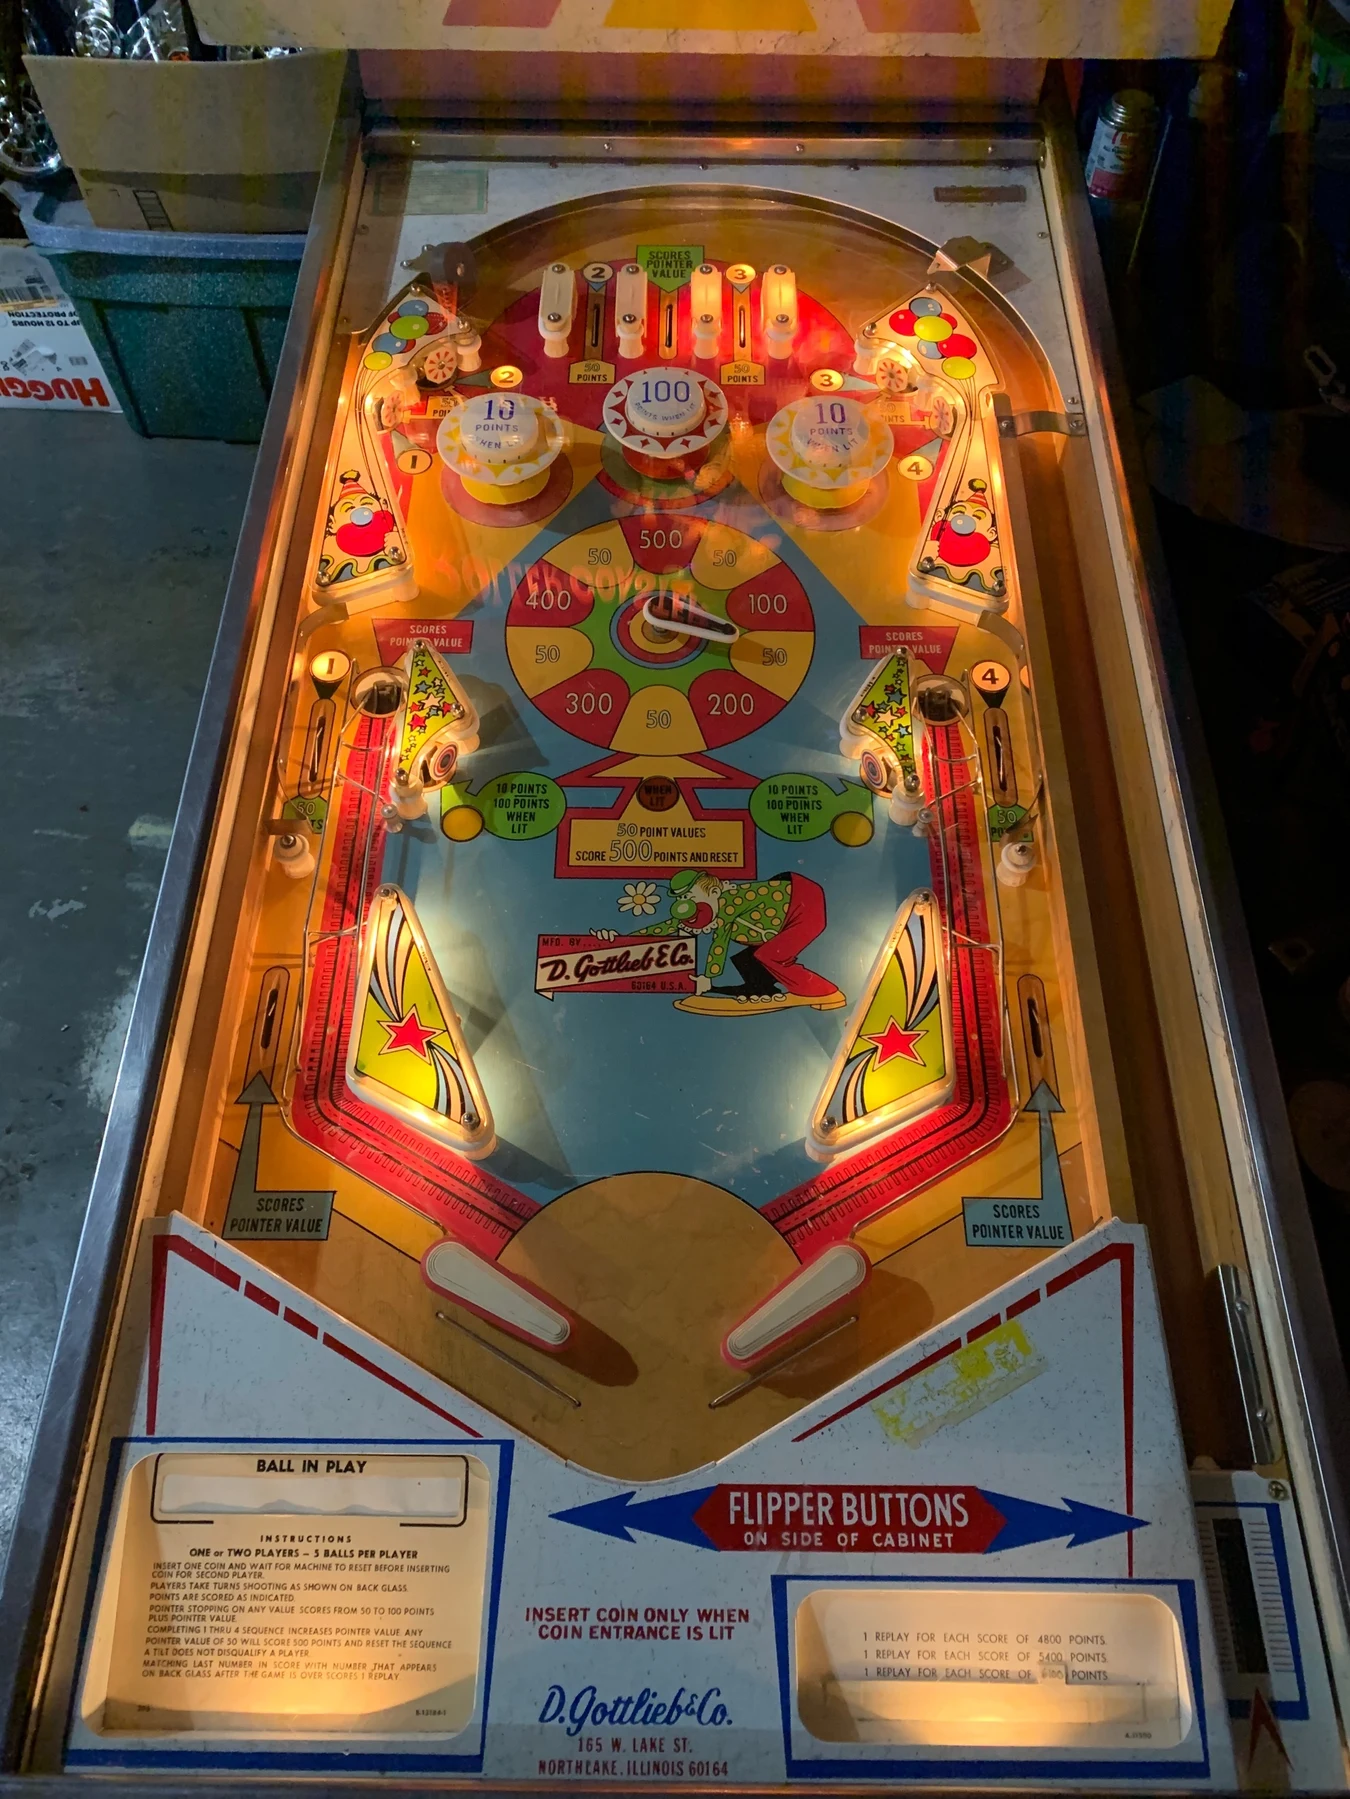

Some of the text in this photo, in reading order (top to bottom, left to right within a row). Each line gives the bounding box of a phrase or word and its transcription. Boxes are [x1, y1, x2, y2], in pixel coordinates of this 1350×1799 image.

[648, 251, 691, 260] SCORES
[646, 260, 693, 269] POINTER
[590, 267, 605, 279] 2
[652, 269, 686, 278] VALUE
[733, 269, 747, 280] 3
[499, 371, 514, 384] 2
[576, 373, 608, 382] POINTS
[727, 374, 759, 383] POINTS
[820, 373, 834, 387] 3
[642, 380, 690, 403] 100
[483, 399, 515, 421] 10
[815, 402, 846, 425] 10
[475, 424, 519, 432] POINTS
[810, 427, 853, 436] POINTS
[907, 461, 923, 475] 4
[639, 529, 682, 549] 500
[587, 548, 612, 565] 50
[712, 550, 737, 567] 50
[526, 590, 571, 610] 400
[748, 593, 787, 614] 100
[409, 624, 447, 634] SCORES
[433, 638, 463, 648] VALUE
[885, 632, 924, 641] SCORES
[535, 645, 560, 663] 50
[911, 644, 942, 654] VALUE
[762, 648, 787, 666] 50
[981, 668, 1000, 685] 4
[565, 692, 613, 714] 300
[707, 693, 754, 715] 200
[646, 710, 672, 729] 50
[496, 783, 548, 795] 10 POINTS
[644, 785, 672, 795] WHEN
[768, 784, 819, 796] 10 POINTS
[296, 801, 315, 814] 50
[493, 798, 550, 809] 100 POINTS
[650, 796, 665, 807] LIT
[766, 799, 823, 811] 100 POINTS
[506, 811, 536, 822] WHEN
[780, 812, 810, 823] WHEN
[997, 809, 1017, 824] 50
[511, 823, 529, 834] LIT
[616, 823, 706, 838] 50 POINT VALUES
[787, 824, 804, 835] LIT
[575, 839, 739, 863] SCORE 500 POINTS AND RESET
[256, 1198, 305, 1212] SCORES
[993, 1204, 1040, 1218] SCORES
[230, 1218, 323, 1232] POINTER VALUE
[972, 1224, 1065, 1240] POINTER VALUE
[256, 1459, 367, 1473] BALL IN PLAY
[729, 1492, 969, 1527] FLIPPER BUTTONS
[260, 1535, 352, 1543] INSTRUCTIONS
[743, 1531, 954, 1547] ON SIDE OF CABINET
[189, 1548, 210, 1557] ONE
[227, 1548, 251, 1558] TWO
[254, 1549, 299, 1558] PLAYERS
[314, 1549, 320, 1558] 5
[323, 1549, 354, 1558] BALLS
[358, 1549, 376, 1558] PER
[379, 1550, 418, 1559] PLAYER
[153, 1562, 450, 1573] INSERT ONE COIN AND WAIT FOR MACHINE TO RESET BEFORE INSERTING
[525, 1607, 750, 1623] INSERT COIN ONLY WHEN
[538, 1625, 735, 1640] COIN ENTRANCE IS LIT
[875, 1632, 909, 1641] REPLAY
[916, 1632, 936, 1642] FOR
[943, 1633, 970, 1643] EACH
[977, 1634, 1008, 1643] SCORE
[1016, 1634, 1029, 1644] OF
[1038, 1634, 1062, 1644] 4800
[876, 1650, 910, 1660] REPLAY
[917, 1650, 936, 1660] FOR
[944, 1651, 971, 1660] EACH
[978, 1651, 1009, 1661] SCORE
[1017, 1652, 1030, 1661] OF
[1038, 1652, 1063, 1662] 5400
[876, 1667, 911, 1677] REPLAY
[918, 1668, 937, 1677] FOR
[945, 1668, 971, 1678] EACH
[979, 1669, 1010, 1679] SCORE
[1018, 1670, 1032, 1679] OF
[1071, 1670, 1108, 1680] POINTS
[578, 1737, 603, 1752] 165
[632, 1738, 665, 1752] LAKE
[673, 1738, 693, 1753] ST.
[627, 1761, 684, 1777] ILLINOIS
[689, 1761, 729, 1776] 60164
